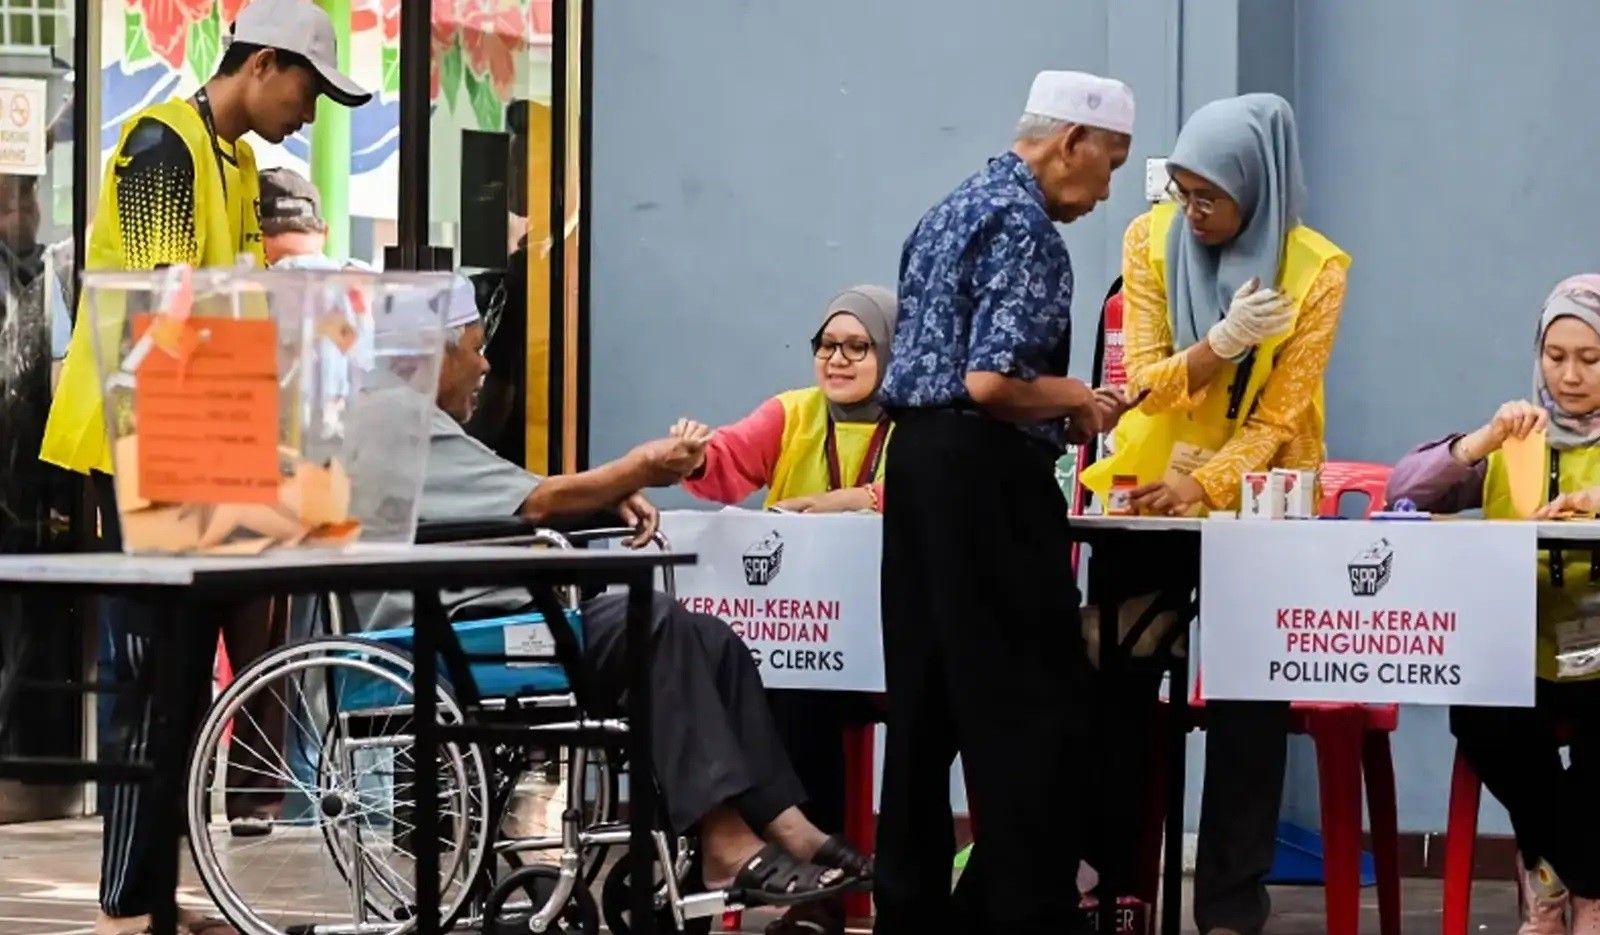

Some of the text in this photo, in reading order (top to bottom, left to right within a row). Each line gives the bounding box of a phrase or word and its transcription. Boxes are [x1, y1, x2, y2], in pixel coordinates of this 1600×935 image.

[1352, 568, 1377, 593] SPR
[730, 621, 829, 642] GUNDIAN
[1277, 608, 1456, 632] KERANI-KERANI
[1287, 633, 1445, 655] PENGUNDIAN
[770, 649, 844, 671] CLERKS
[1270, 661, 1461, 686] POLLING CLERKS
